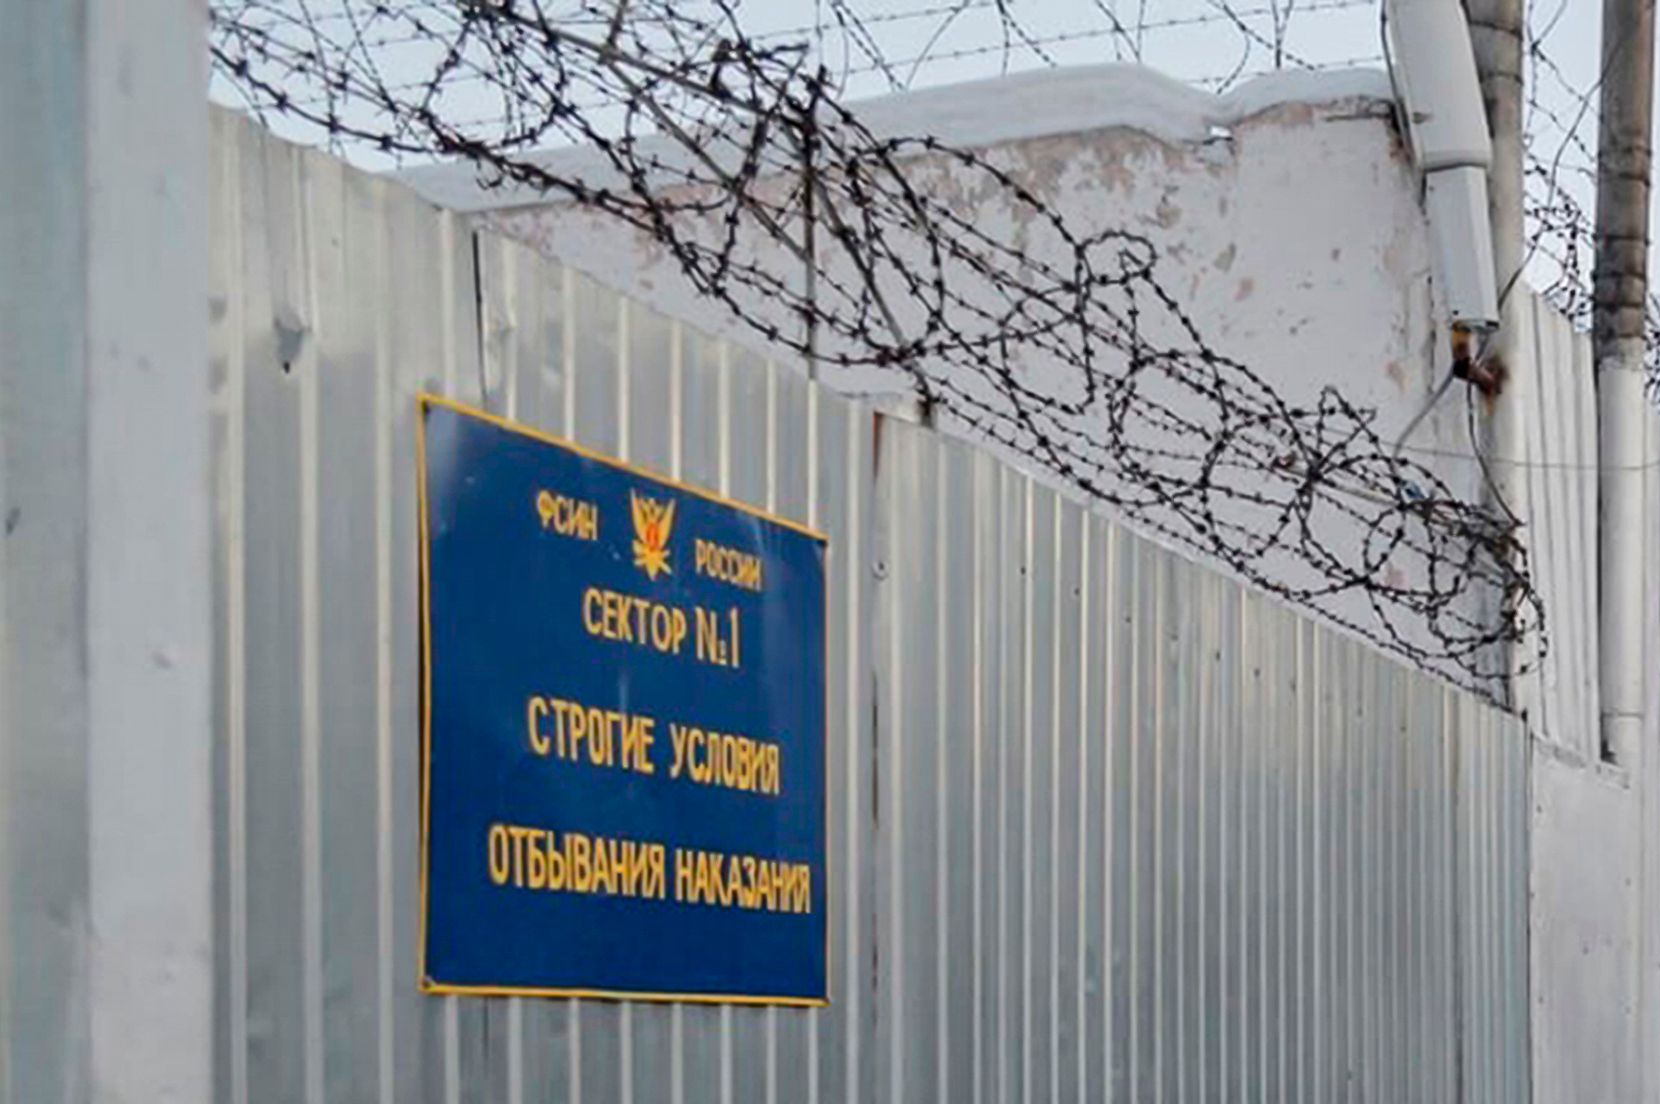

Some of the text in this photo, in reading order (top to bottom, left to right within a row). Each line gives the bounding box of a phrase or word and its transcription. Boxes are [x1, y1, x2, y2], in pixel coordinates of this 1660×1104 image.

[537, 490, 762, 591] ФСИН РОССИИ
[583, 588, 686, 654] СЕКТОР
[527, 696, 780, 796] СТРОГИЕ УСЛОВИЯ
[488, 824, 812, 914] ОТБЫВАНИЯ НАКАЗАНИЯ
